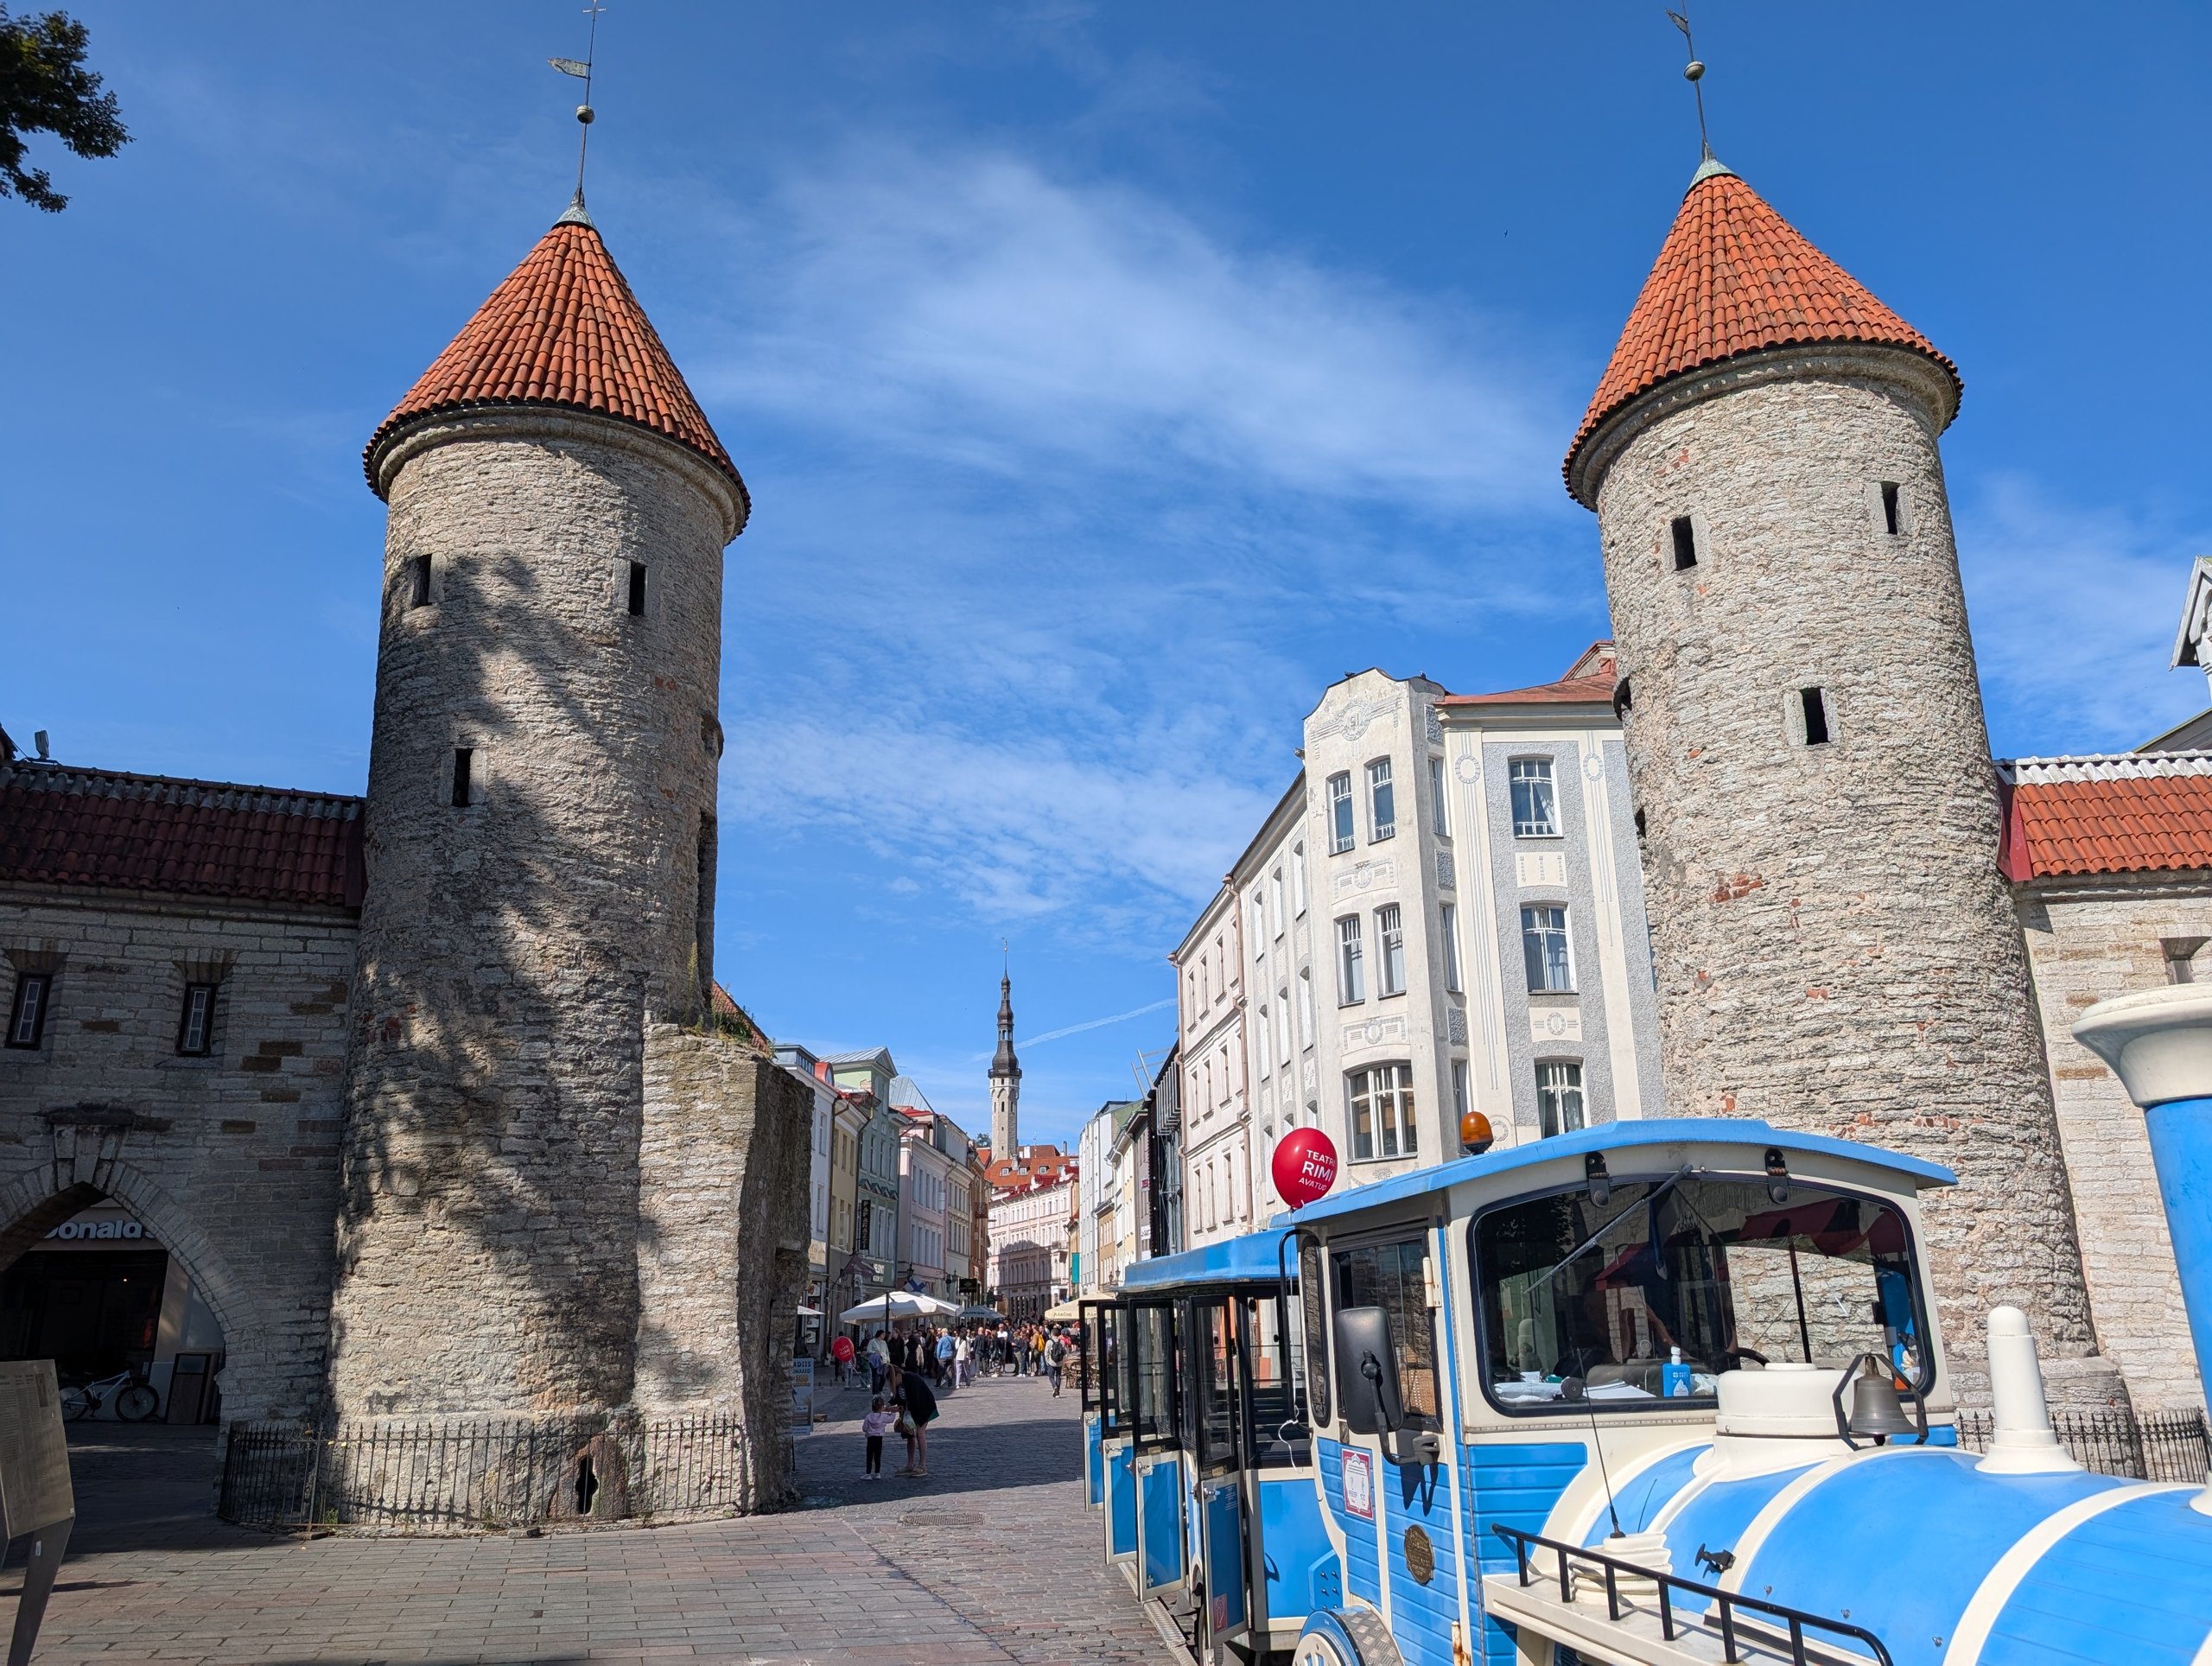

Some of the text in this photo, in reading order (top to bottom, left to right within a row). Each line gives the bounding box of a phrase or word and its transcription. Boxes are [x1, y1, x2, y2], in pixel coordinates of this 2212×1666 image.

[1306, 1149, 1336, 1167] TEATRI
[1301, 1160, 1333, 1182] RIMI
[1298, 1177, 1327, 1191] AVATUD
[43, 1220, 156, 1239] onald
